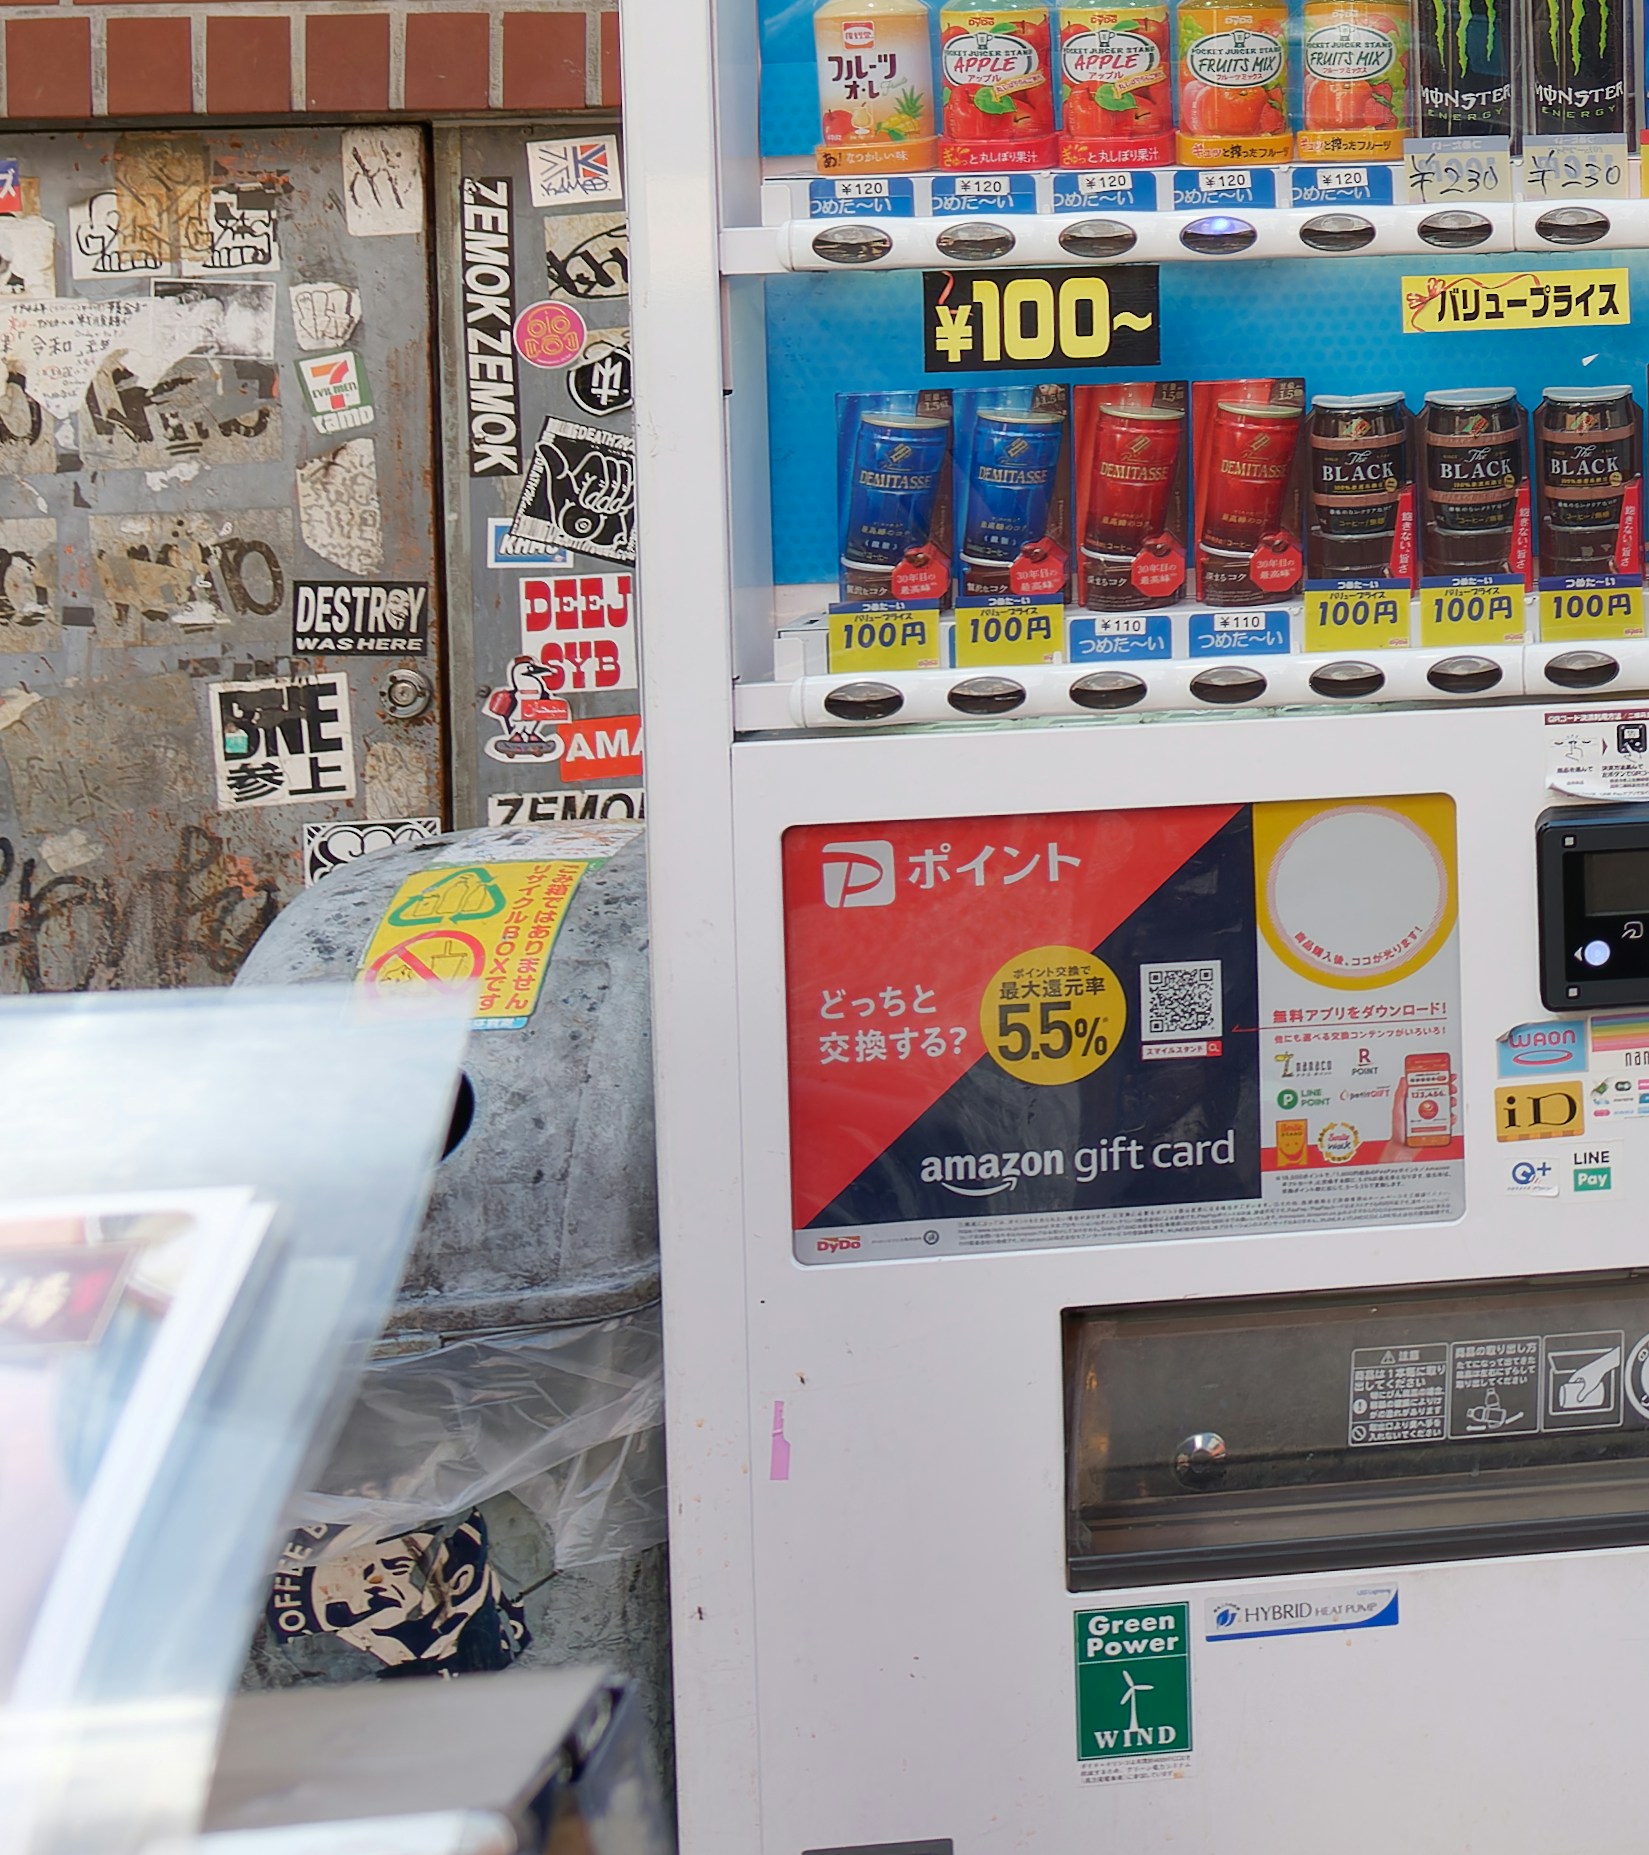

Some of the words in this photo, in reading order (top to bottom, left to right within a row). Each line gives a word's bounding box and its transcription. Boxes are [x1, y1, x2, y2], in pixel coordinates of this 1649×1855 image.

[828, 54, 897, 82] フルーツ
[953, 55, 1018, 73] APPLE
[1199, 56, 1248, 73] FRUITS
[1253, 55, 1279, 71] MIX
[1540, 105, 1616, 118] ENERGY
[841, 182, 884, 195] ¥120
[1322, 172, 1362, 185] ¥120
[1437, 281, 1621, 322] バリュープライス
[466, 178, 518, 474] ZEMOKZEMOK
[1550, 456, 1621, 476] BLACK
[859, 470, 932, 490] DEMITASSE
[297, 584, 423, 635] DESTROY
[525, 575, 630, 632] DEEJ
[1553, 593, 1633, 619] 100円
[295, 636, 352, 653] WAS
[356, 635, 424, 653] HERE
[843, 622, 928, 649] 100円
[540, 641, 622, 689] SYB
[225, 762, 349, 801] 参上
[908, 843, 1082, 889] ポイント
[479, 864, 552, 1012] リサイクルBOXです
[999, 977, 1106, 1000] 最大還元率
[819, 986, 936, 1021] どっちと
[1272, 1001, 1447, 1024] 無料アプリをダウンロード!
[998, 999, 1108, 1061] 5.5%
[1509, 1028, 1577, 1049] WAON
[819, 1027, 967, 1066] 交換する?
[920, 1147, 1066, 1186] amazon
[1073, 1138, 1145, 1186] gift
[1152, 1130, 1235, 1169] card
[1574, 1151, 1610, 1164] LINE
[1578, 1171, 1609, 1190] Pay
[1087, 1613, 1176, 1634] Green
[1244, 1600, 1311, 1623] HYBRID
[1315, 1602, 1342, 1618] HEAT
[1345, 1600, 1377, 1616] PUMP
[1085, 1634, 1180, 1658] Power
[1095, 1724, 1176, 1748] WIND
